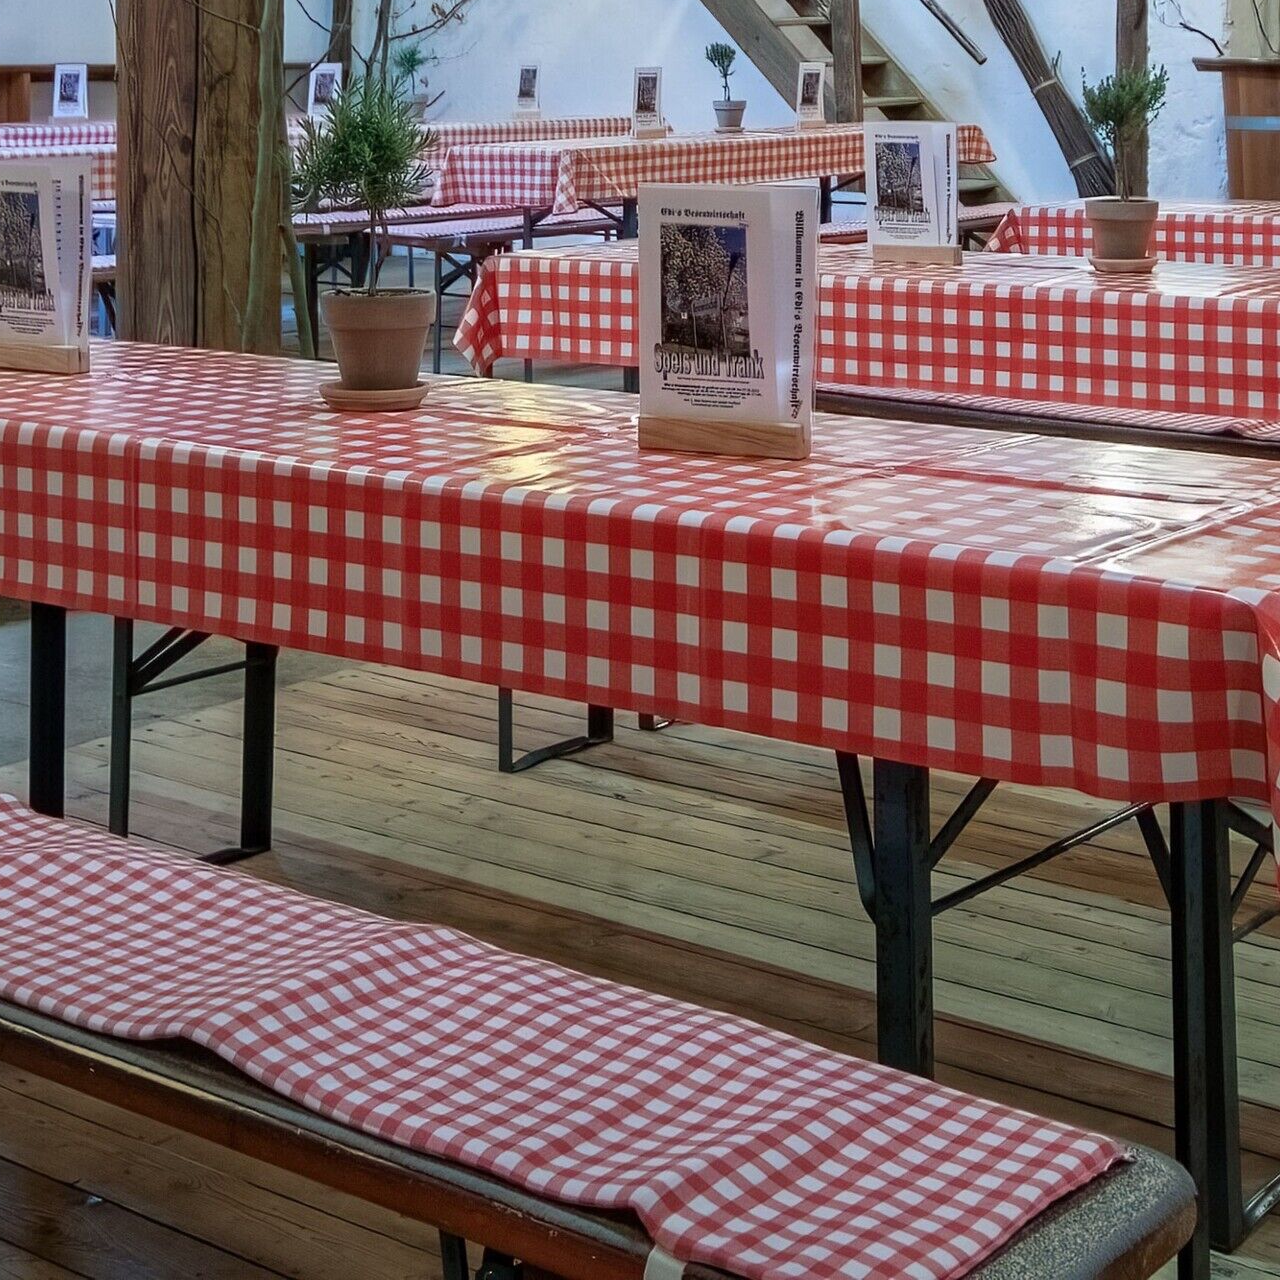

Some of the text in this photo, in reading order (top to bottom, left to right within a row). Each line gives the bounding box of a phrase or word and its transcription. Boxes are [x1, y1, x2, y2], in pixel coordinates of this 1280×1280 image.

[794, 210, 805, 275] Willkommen
[794, 278, 804, 288] in
[654, 343, 764, 380] Speis und Trank
